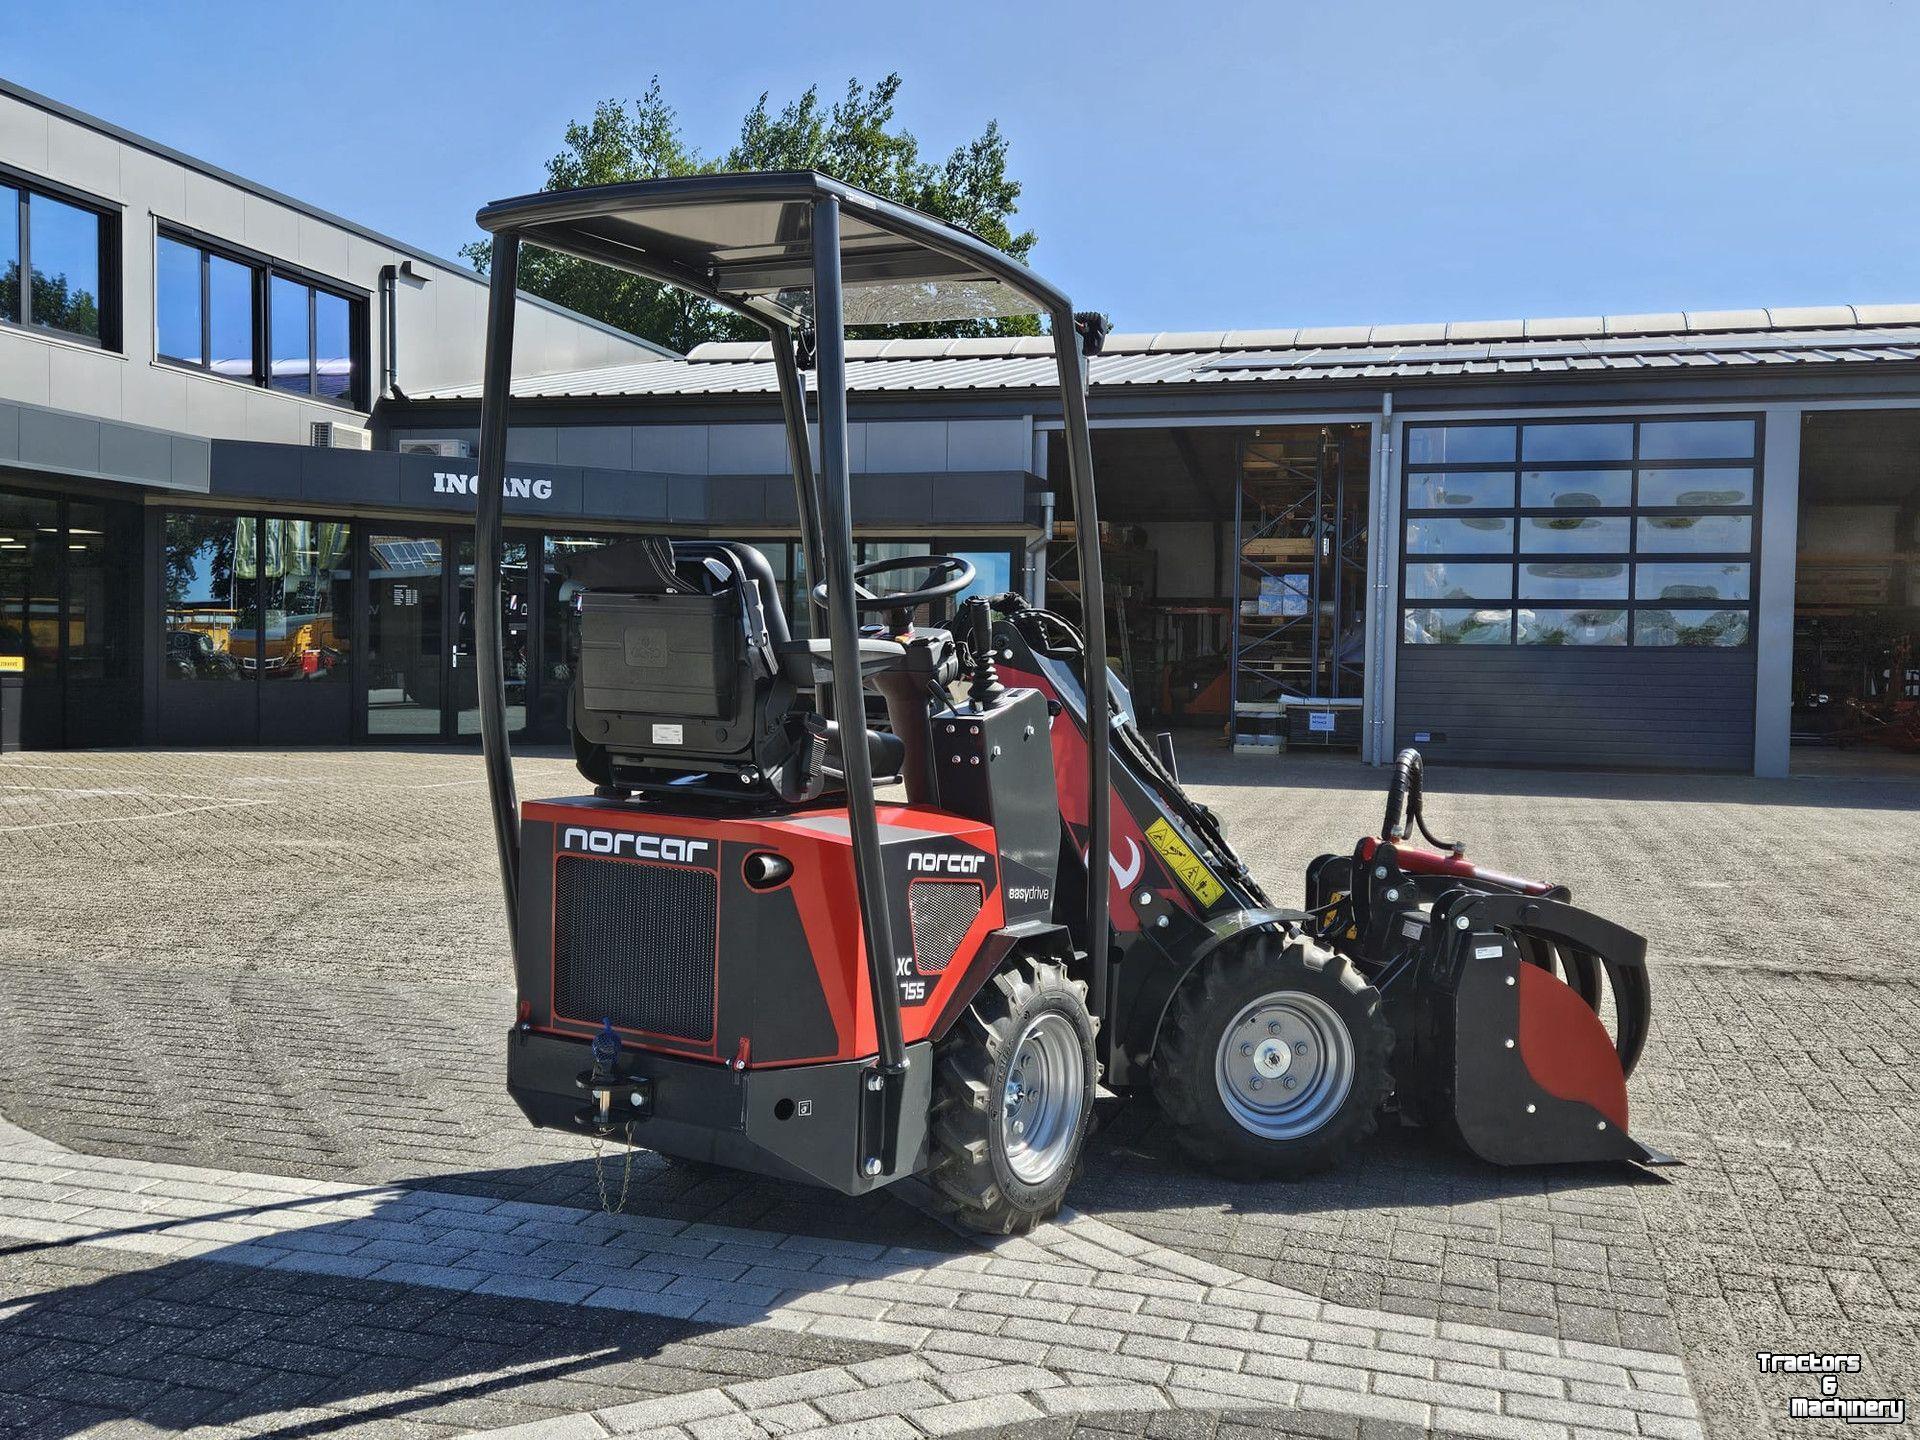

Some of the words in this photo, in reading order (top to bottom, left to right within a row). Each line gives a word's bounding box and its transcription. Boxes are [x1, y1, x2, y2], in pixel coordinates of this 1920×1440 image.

[564, 828, 709, 863] norcar
[907, 852, 986, 874] norcar
[1009, 885, 1049, 903] easydrive
[896, 957, 913, 976] XC
[900, 982, 925, 1000] 755
